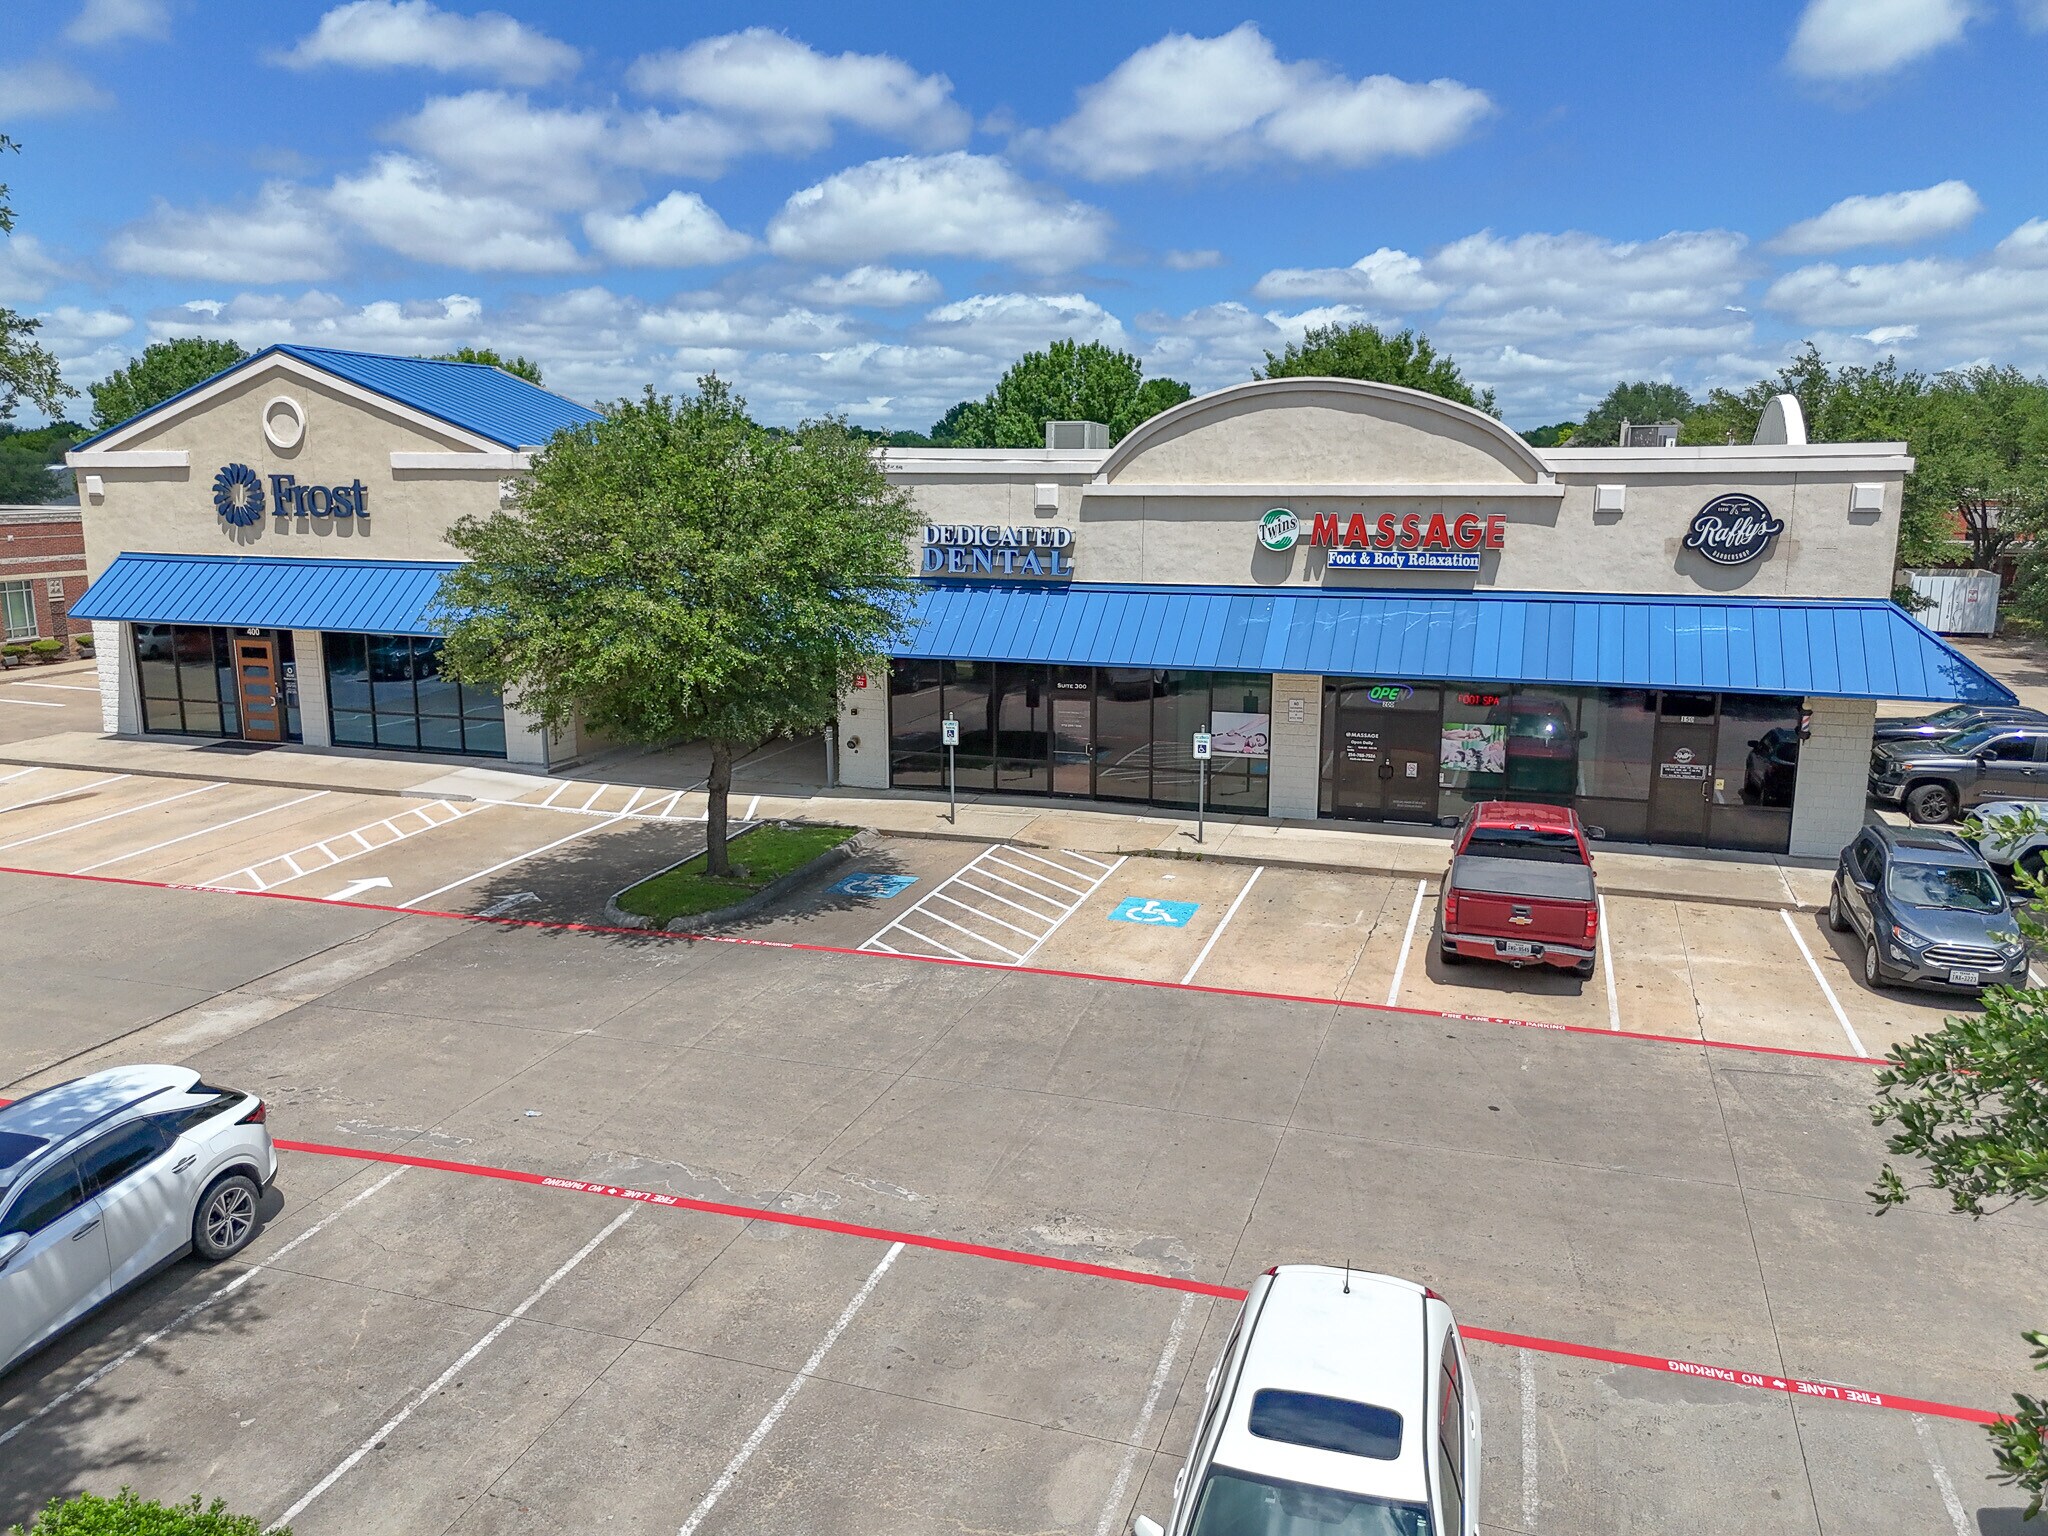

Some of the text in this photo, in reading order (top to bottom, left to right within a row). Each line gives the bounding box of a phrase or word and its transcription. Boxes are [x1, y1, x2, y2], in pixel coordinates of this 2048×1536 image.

[268, 475, 370, 518] Frost
[923, 525, 1072, 548] DEDICATED
[1259, 517, 1297, 543] Twins
[1310, 512, 1507, 549] MASSAGE
[1687, 514, 1779, 547] Raffy's
[922, 547, 1072, 576] DENTAL
[1328, 552, 1479, 568] Foot & Body Relaxation
[246, 628, 260, 636] 400
[1371, 686, 1409, 701] OPEN
[1525, 1022, 1566, 1031] PARKING
[542, 1177, 677, 1204] FIRE LANE NO PARKING
[1668, 1360, 1882, 1405] FIRE LANE NO PARKING
